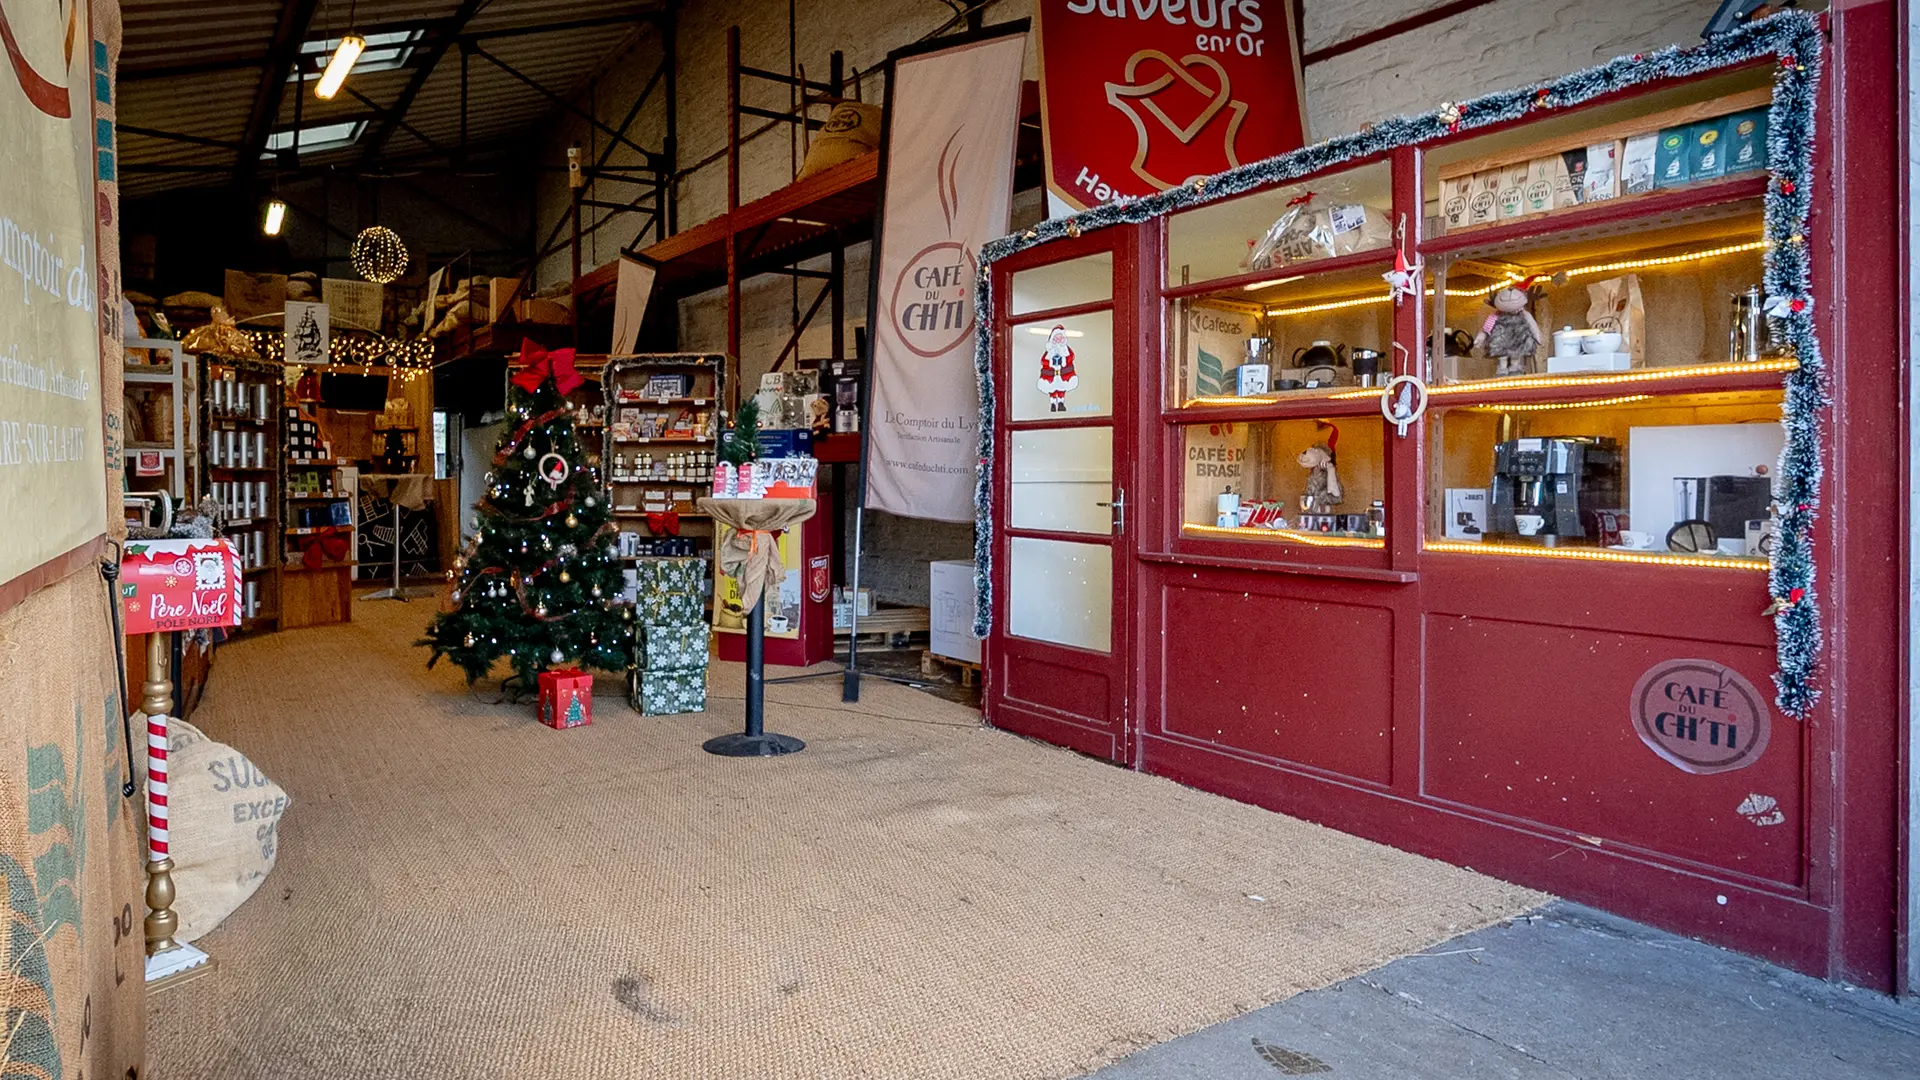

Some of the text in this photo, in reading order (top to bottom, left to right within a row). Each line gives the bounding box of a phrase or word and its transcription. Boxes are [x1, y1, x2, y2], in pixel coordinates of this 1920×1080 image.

[0, 216, 62, 305] mptoir
[925, 290, 940, 300] DU
[896, 412, 939, 430] Comptoir
[941, 418, 954, 429] du
[150, 591, 228, 619] Père Noël
[156, 615, 222, 628] PÔLE NORD
[1679, 703, 1696, 715] DU
